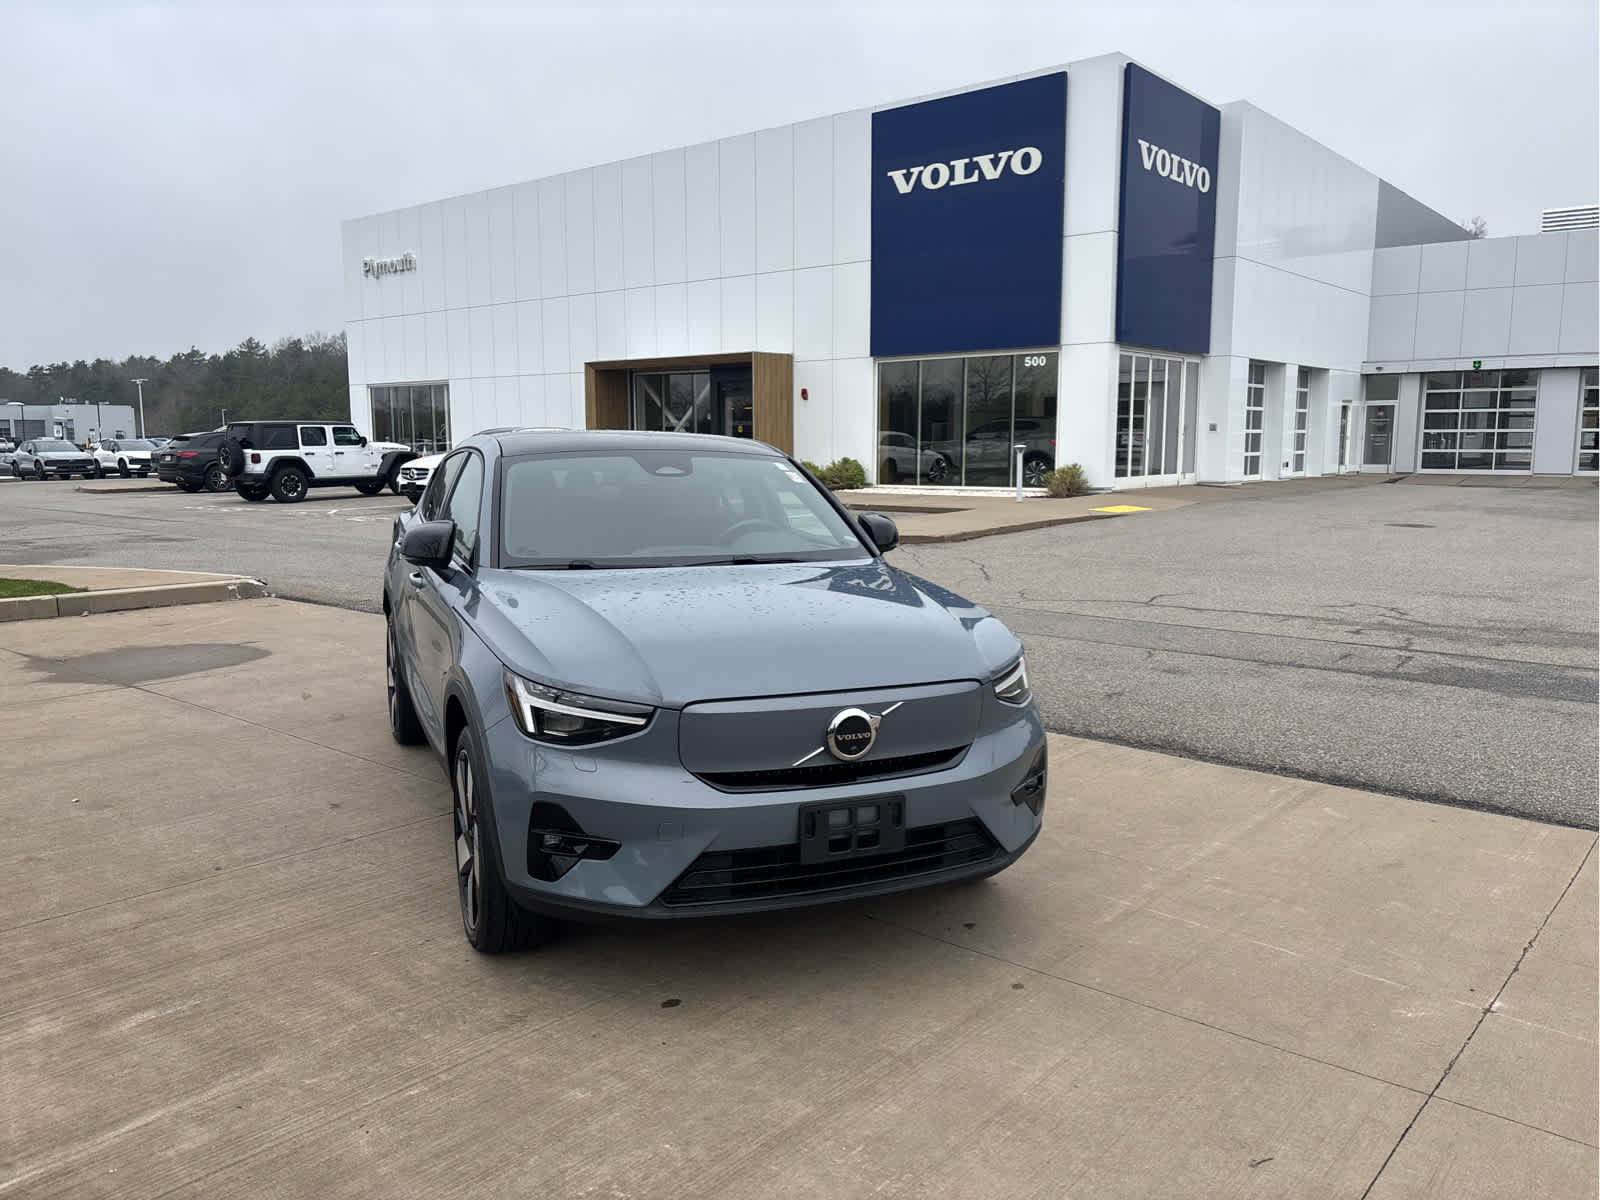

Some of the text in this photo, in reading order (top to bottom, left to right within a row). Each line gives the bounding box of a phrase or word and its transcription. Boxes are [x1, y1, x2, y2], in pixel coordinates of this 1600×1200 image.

[887, 147, 1042, 194] VOLVO
[1138, 139, 1210, 193] VOLVO
[1024, 356, 1046, 367] 500
[836, 732, 871, 741] VOLVO
